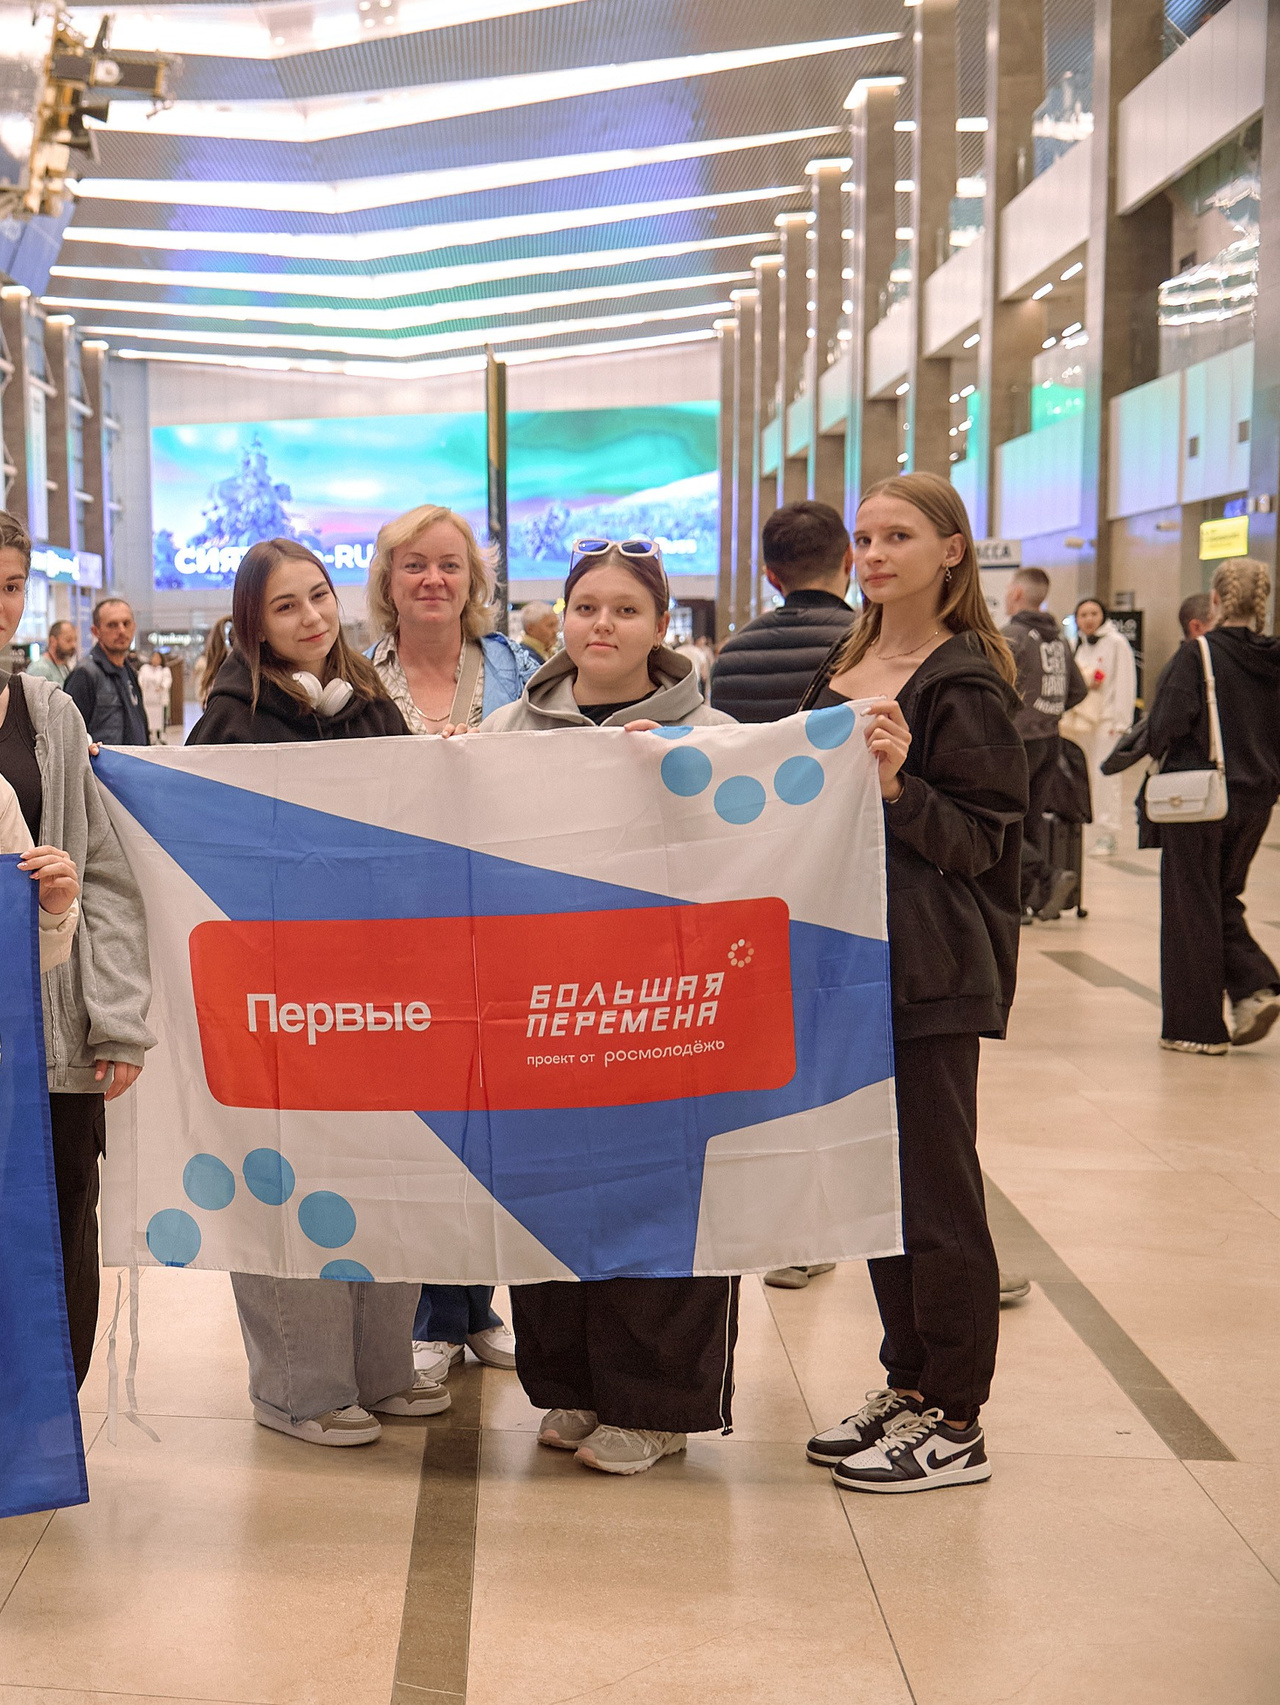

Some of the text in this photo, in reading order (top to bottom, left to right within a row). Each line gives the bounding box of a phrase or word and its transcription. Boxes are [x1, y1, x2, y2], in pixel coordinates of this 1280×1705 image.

[320, 544, 373, 569] -RU
[529, 971, 725, 1010] БОЛЬШАЯ
[246, 993, 432, 1046] Первые
[526, 1000, 719, 1038] ПЕРЕМЕНА
[527, 1039, 725, 1068] проект от росмолодёжь
